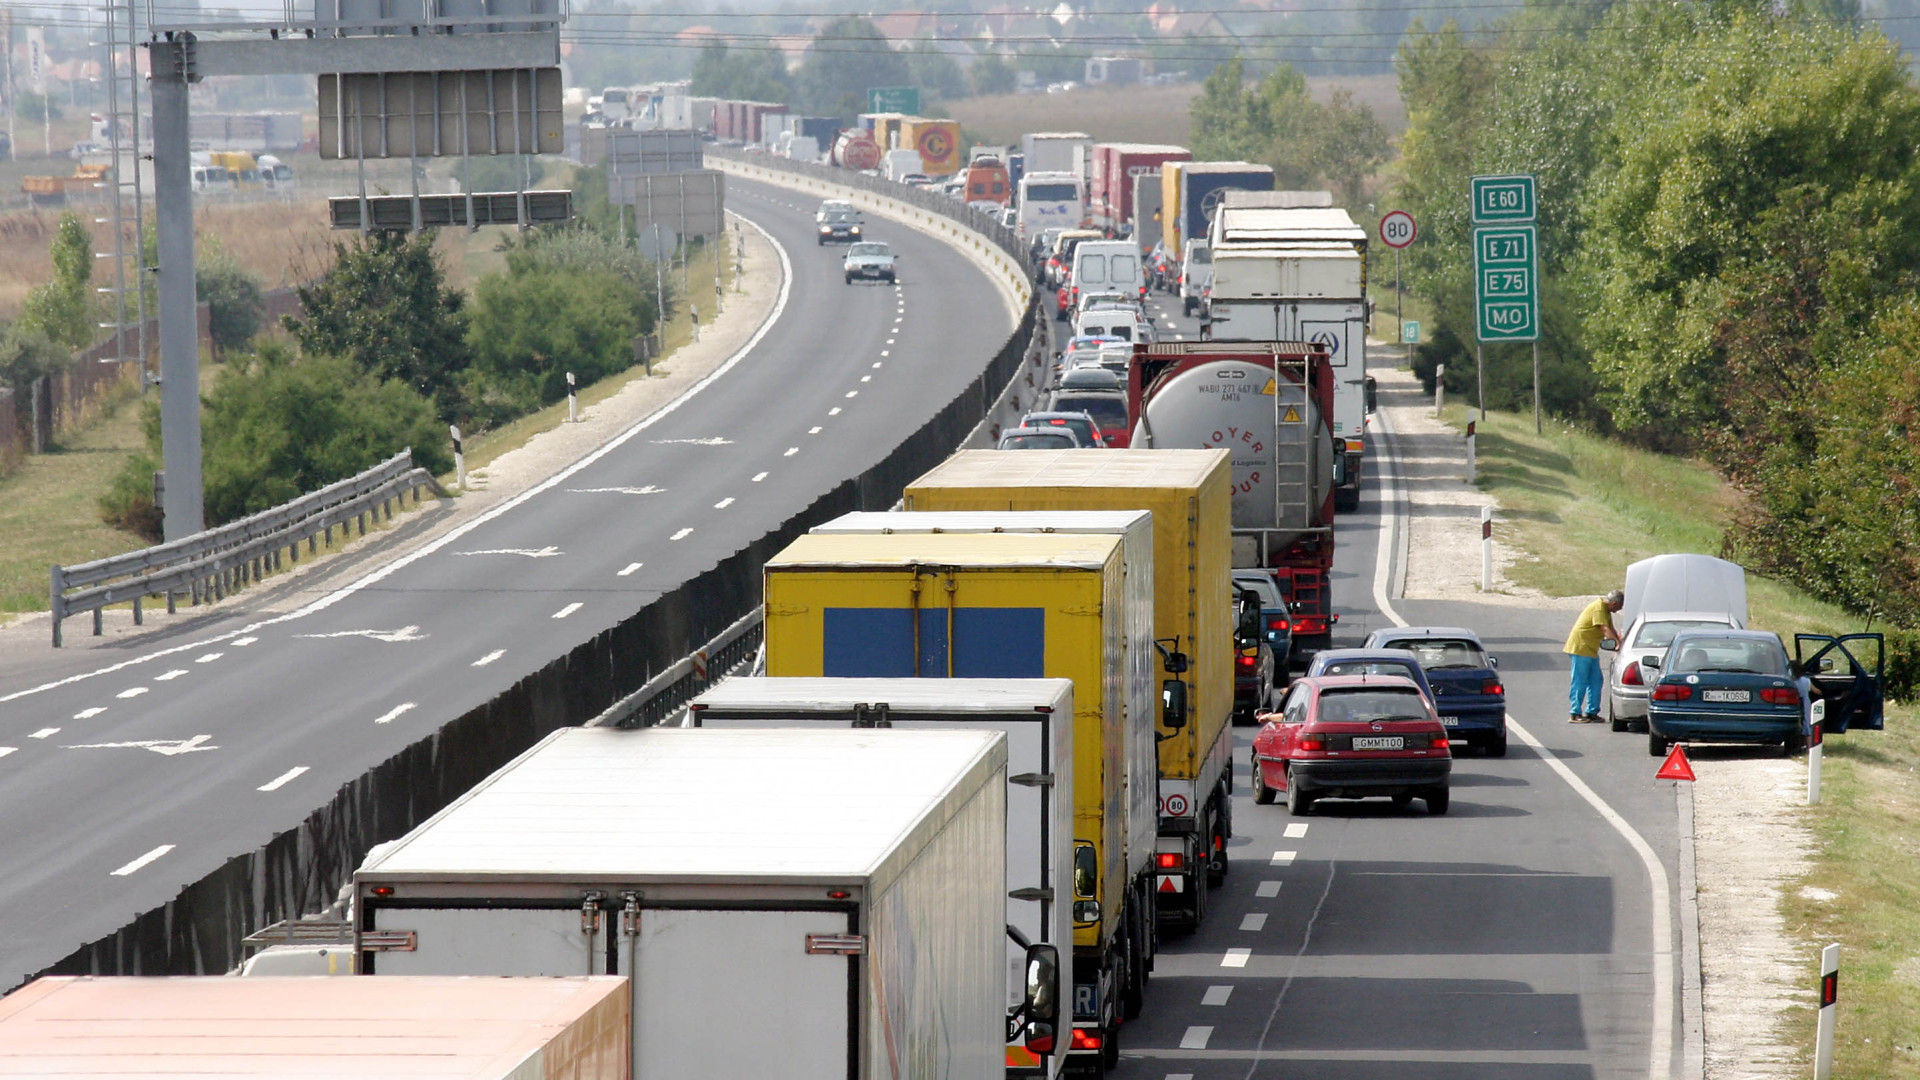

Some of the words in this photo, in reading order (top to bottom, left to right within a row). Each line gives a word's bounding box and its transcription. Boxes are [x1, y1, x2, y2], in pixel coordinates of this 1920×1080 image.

[1489, 192, 1496, 207] E
[1499, 191, 1517, 207] 60
[1387, 222, 1408, 238] 80
[1490, 241, 1498, 257] E
[1504, 241, 1518, 256] 71
[1489, 275, 1499, 290] E
[1503, 274, 1523, 290] 75
[1405, 327, 1415, 338] 18
[1171, 801, 1183, 810] 80
